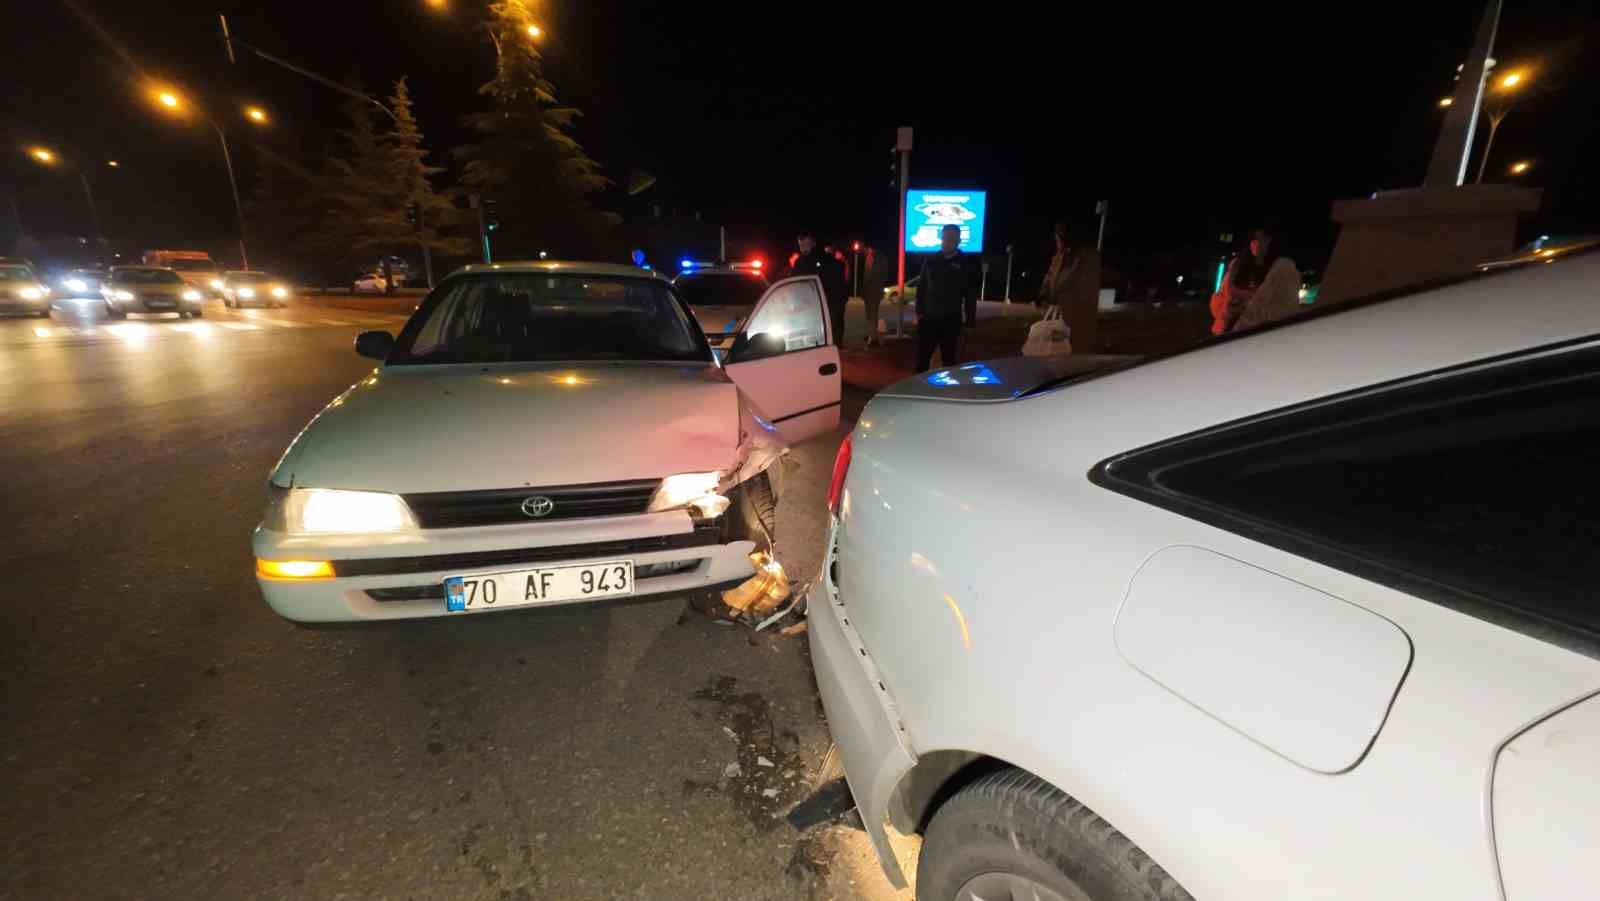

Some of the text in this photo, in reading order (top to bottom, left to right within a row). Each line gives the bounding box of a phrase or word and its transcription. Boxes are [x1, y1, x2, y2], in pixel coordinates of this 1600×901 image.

[450, 566, 626, 606] TR 70 AF 943
